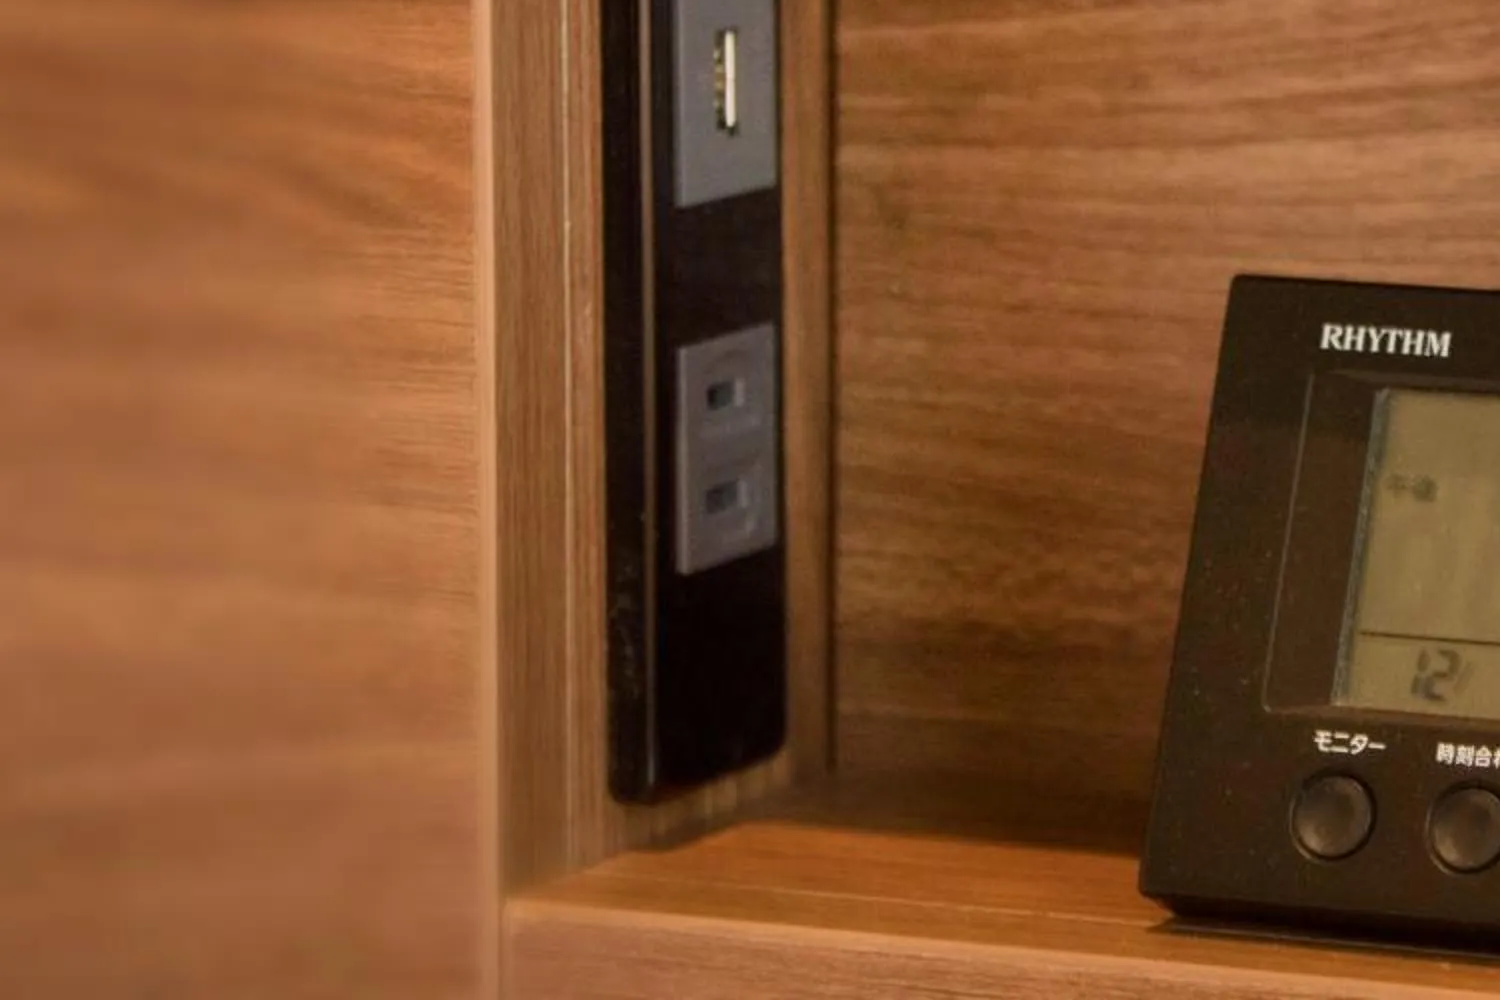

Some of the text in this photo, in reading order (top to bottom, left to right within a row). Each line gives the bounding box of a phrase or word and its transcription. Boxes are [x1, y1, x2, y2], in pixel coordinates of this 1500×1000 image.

[1320, 323, 1452, 358] RHYTHM
[1313, 729, 1387, 755] モニター
